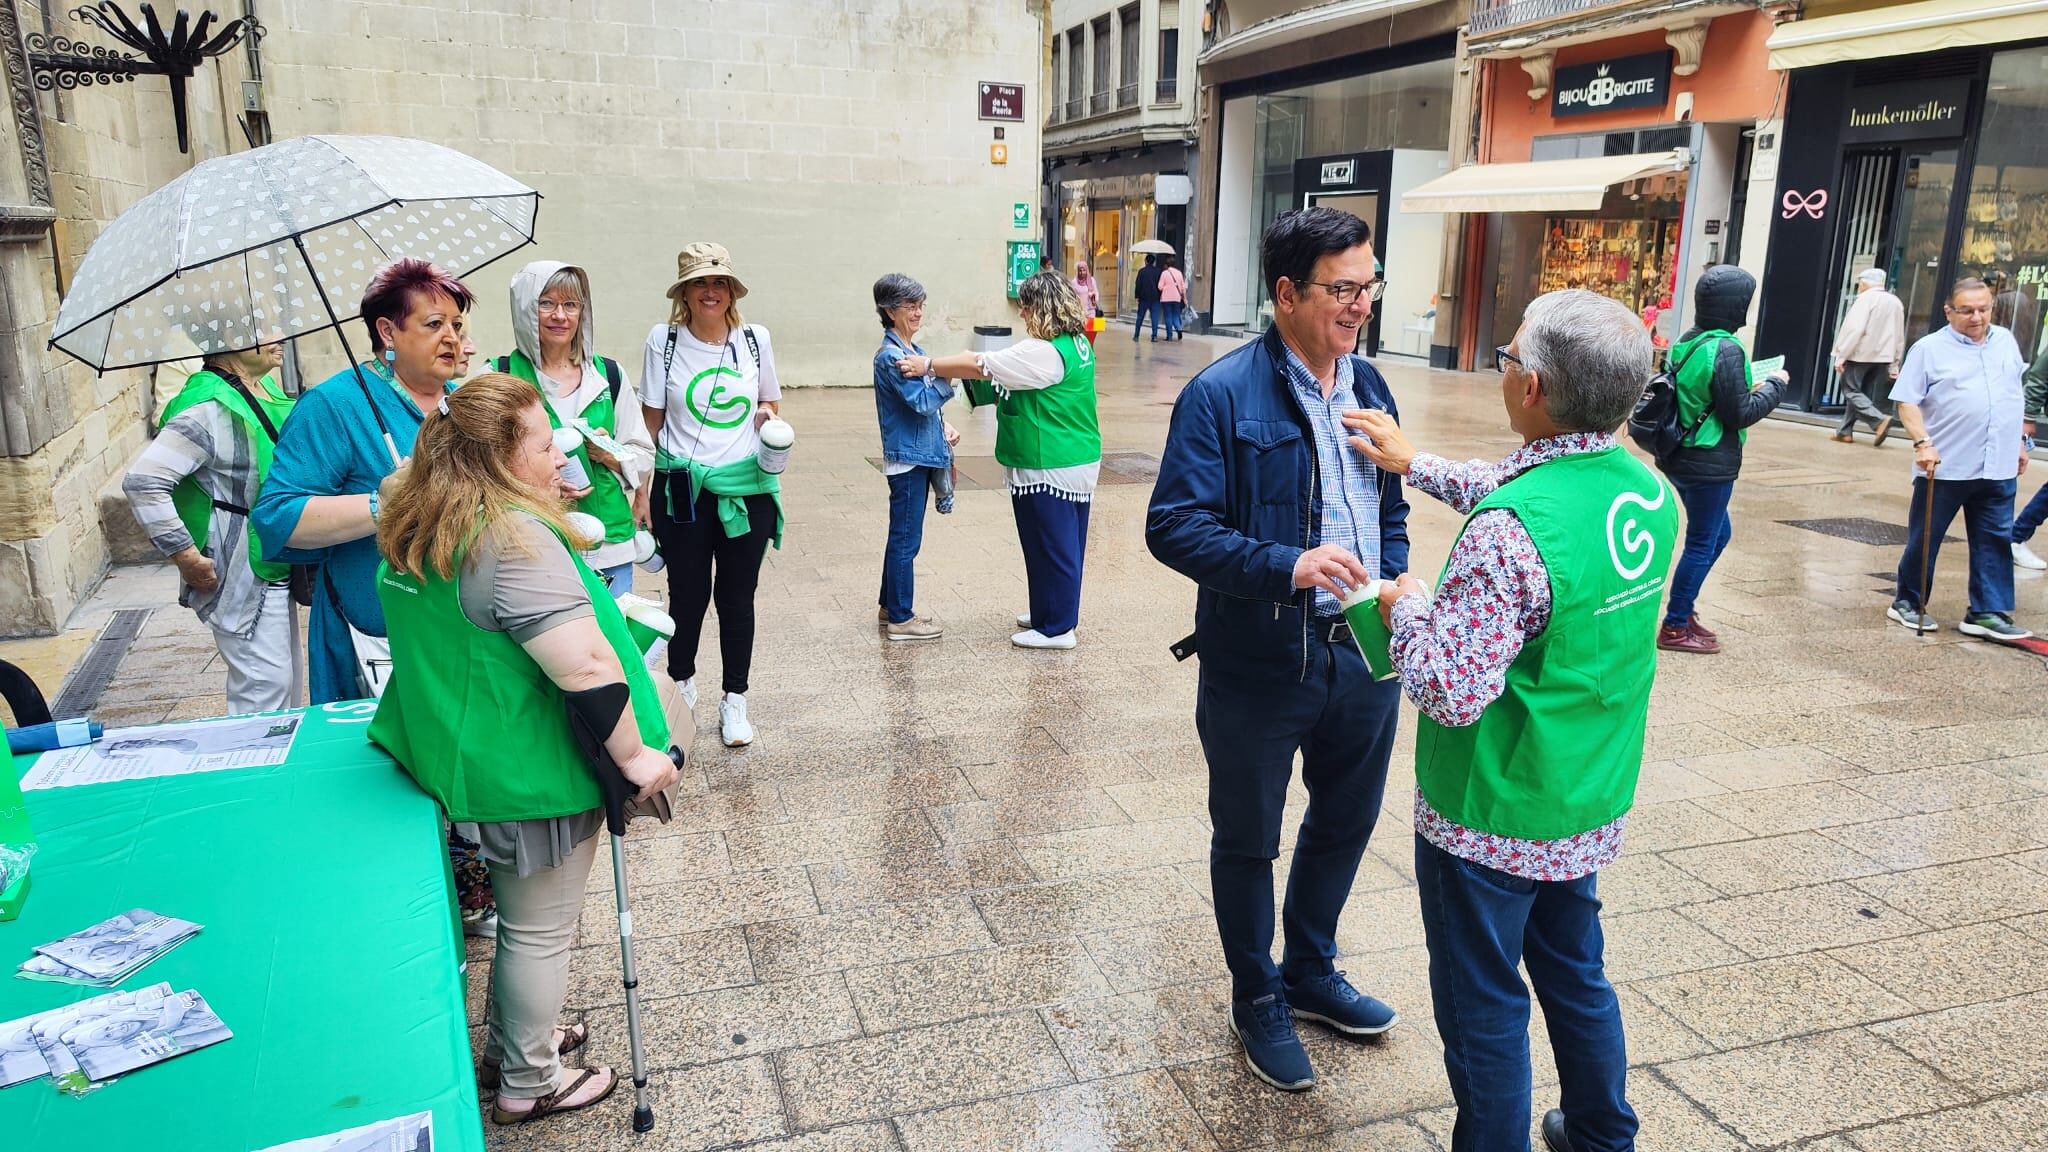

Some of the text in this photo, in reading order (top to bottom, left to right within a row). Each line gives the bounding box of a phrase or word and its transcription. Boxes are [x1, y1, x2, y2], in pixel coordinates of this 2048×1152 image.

[992, 97, 1008, 107] de la
[1558, 87, 1589, 107] BIJOU
[1017, 243, 1036, 253] DEA
